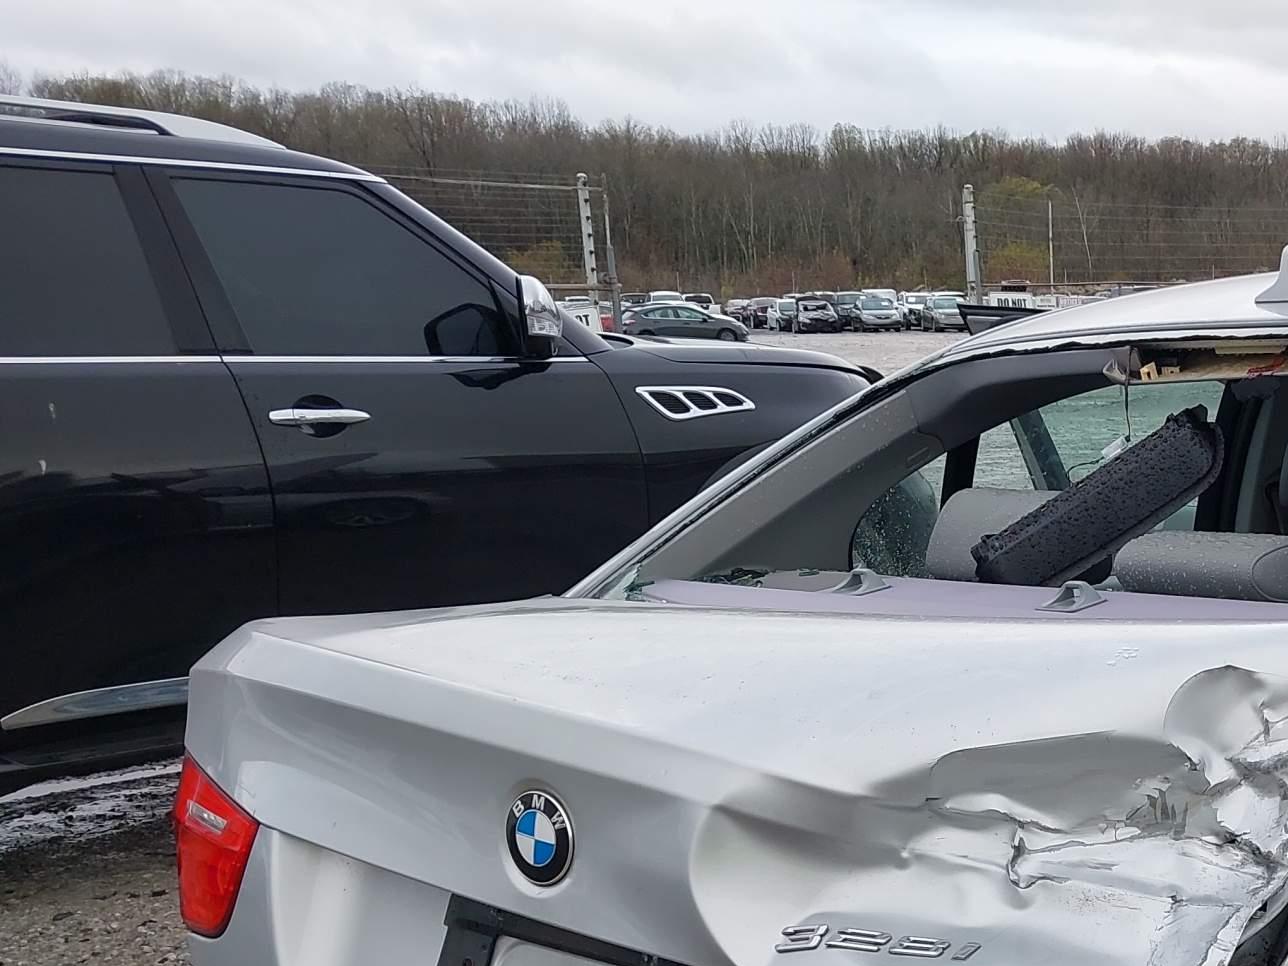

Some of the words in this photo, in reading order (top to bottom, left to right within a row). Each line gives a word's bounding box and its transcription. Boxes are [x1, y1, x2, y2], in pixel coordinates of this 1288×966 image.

[997, 298, 1009, 308] DO
[1011, 298, 1027, 309] NOT
[575, 314, 590, 327] OT
[513, 794, 567, 830] BMW
